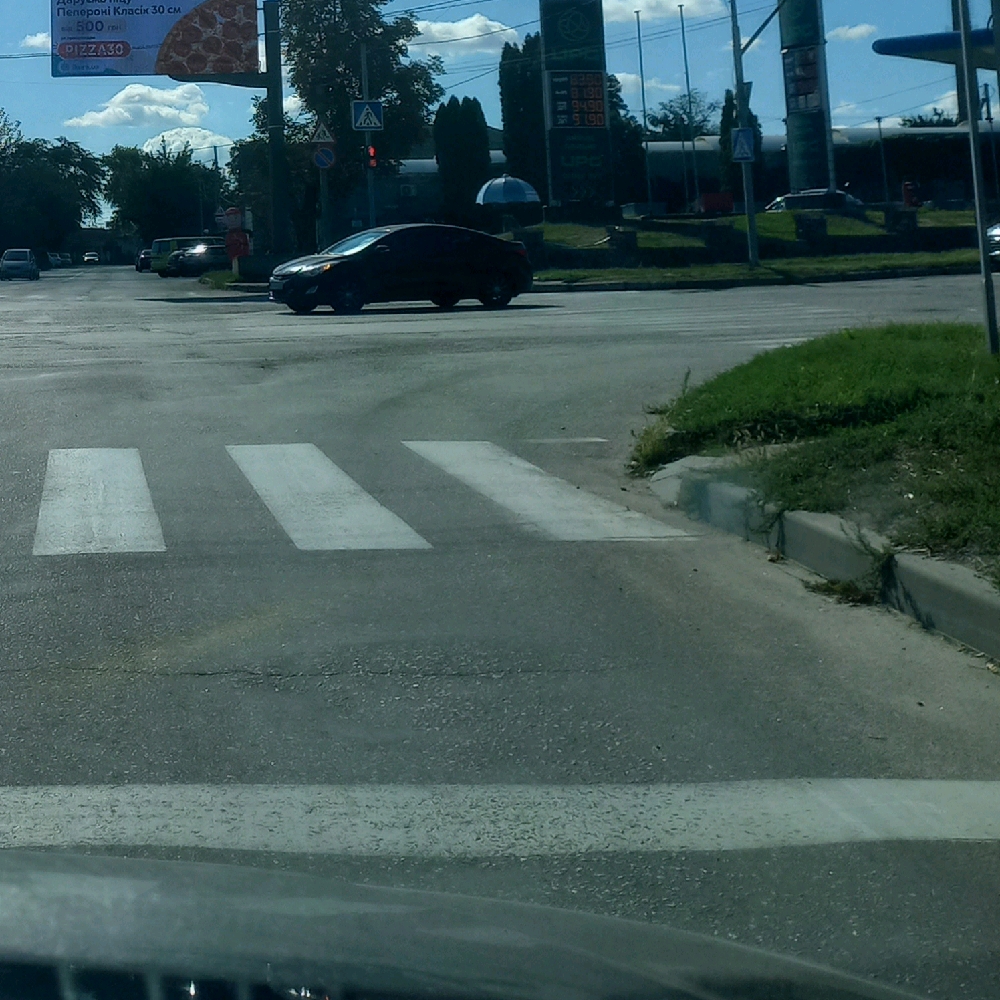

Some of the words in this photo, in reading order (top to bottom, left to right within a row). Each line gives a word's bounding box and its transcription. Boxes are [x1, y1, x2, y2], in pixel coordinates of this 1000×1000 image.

[56, 6, 111, 18] Пепероні
[113, 5, 149, 16] Класік
[151, 5, 165, 14] 30
[168, 6, 182, 14] см
[76, 20, 104, 32] 500
[65, 44, 124, 56] PIZZA30
